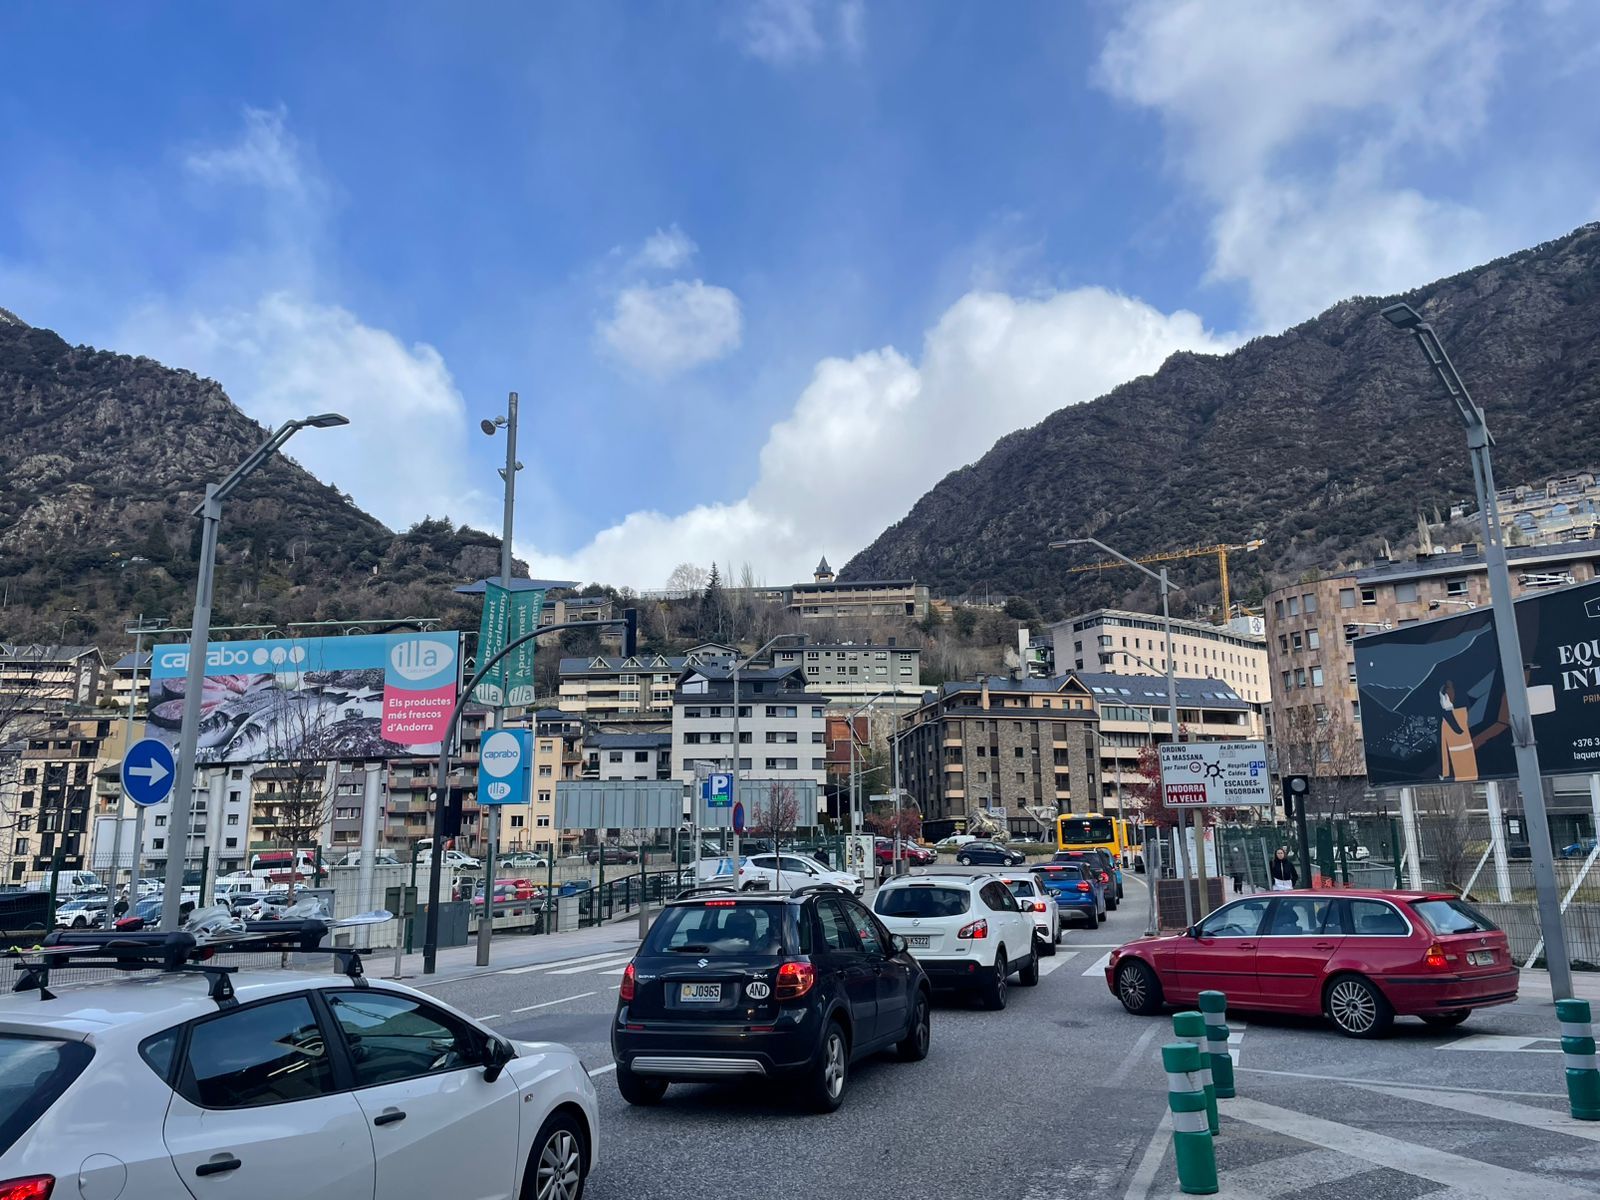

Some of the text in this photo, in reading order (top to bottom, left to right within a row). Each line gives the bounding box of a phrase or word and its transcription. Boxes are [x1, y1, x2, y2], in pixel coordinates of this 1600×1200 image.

[484, 600, 496, 675] parcament
[516, 605, 527, 678] Aparcment
[161, 647, 248, 671] caabo
[399, 640, 437, 667] illa
[389, 698, 451, 708] Els productes
[388, 710, 442, 719] més frescos
[1572, 737, 1593, 748] +376
[484, 749, 518, 760] caprabo
[490, 783, 505, 794] illa
[711, 775, 729, 795] P
[1167, 784, 1205, 793] ANDORRA
[1224, 779, 1260, 787] ESCALDES-
[1180, 794, 1204, 803] VELLA
[691, 985, 720, 998] J0965
[750, 983, 767, 997] AND
